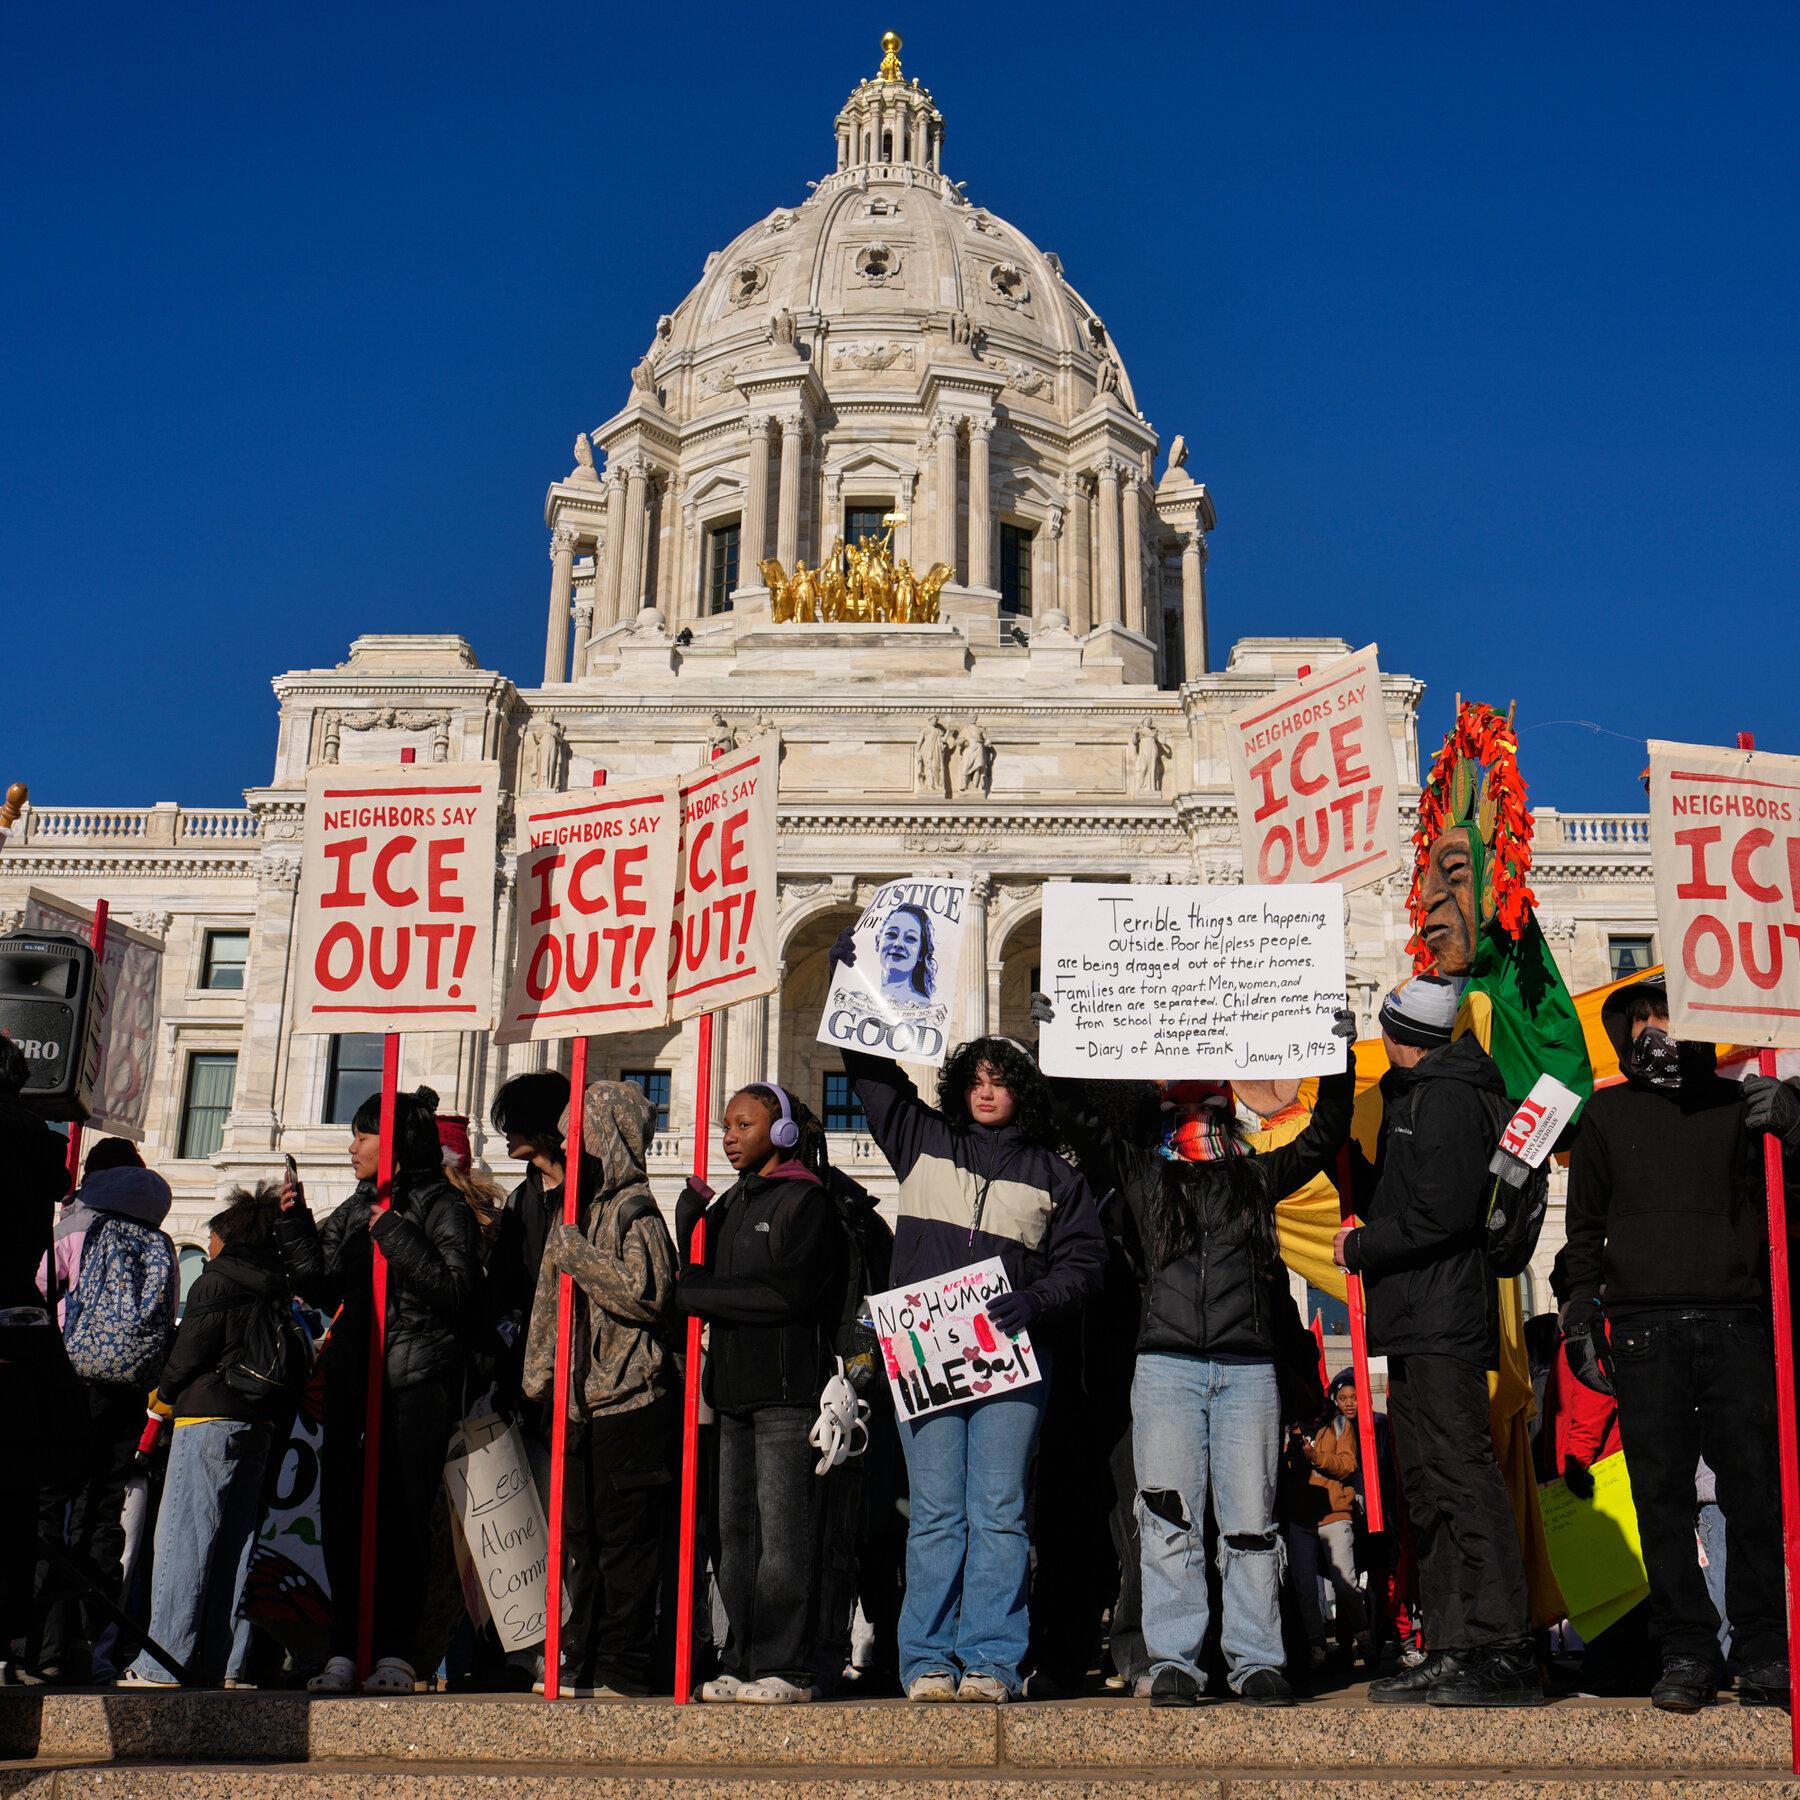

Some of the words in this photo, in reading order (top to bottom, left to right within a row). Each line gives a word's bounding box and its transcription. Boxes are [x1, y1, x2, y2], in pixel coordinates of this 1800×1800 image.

[1244, 699, 1333, 758] NEIGHBORS
[1337, 684, 1367, 711] SAY
[1249, 714, 1371, 824] ICE
[324, 806, 436, 831] NEIGHBORS
[441, 807, 477, 827] SAY
[679, 789, 729, 828] GHBORS
[732, 777, 758, 805] SAY
[1672, 794, 1793, 822] NEIGHBORS
[530, 818, 624, 852] NEIGHBORS
[628, 816, 661, 837] SAY
[1257, 784, 1384, 884] OUT!
[320, 835, 465, 913] ICE
[530, 845, 648, 926] ICE
[855, 909, 882, 933] for
[864, 884, 965, 924] JUSTICE
[1098, 897, 1181, 933] Terrible
[1188, 902, 1233, 938] things
[1238, 913, 1258, 923] are
[1263, 902, 1326, 930] happening
[314, 920, 477, 999] OUT!
[526, 924, 656, 1001] OUT!
[1108, 935, 1169, 952] outside.
[1171, 935, 1200, 952] Poor
[1204, 935, 1255, 955] helpless
[1259, 934, 1312, 953] people
[1057, 958, 1078, 969] are
[1082, 954, 1119, 977] being
[1126, 957, 1180, 980] dragged
[1188, 957, 1208, 969] out
[1213, 956, 1227, 968] of
[1230, 956, 1265, 969] their
[1268, 955, 1315, 969] homes.
[1054, 975, 1114, 1004] Families
[1118, 985, 1136, 995] are
[1140, 979, 1167, 995] torn
[1171, 979, 1207, 997] apart.
[1208, 974, 1237, 991] Men,
[1238, 979, 1280, 990] women,
[1280, 974, 1302, 987] and
[1070, 1000, 1122, 1014] children
[1127, 1001, 1145, 1011] are
[1154, 996, 1218, 1011] separated.
[1223, 992, 1276, 1008] Children
[1280, 993, 1309, 1003] come
[1313, 990, 1346, 1001] home
[828, 1010, 943, 1057] GOOD
[1075, 1015, 1104, 1030] from
[1113, 1013, 1152, 1027] school
[1159, 1013, 1175, 1026] to
[1178, 1012, 1207, 1026] find
[1212, 1011, 1238, 1025] that
[1240, 1009, 1270, 1022] their
[1271, 1005, 1311, 1022] parents
[1315, 1003, 1342, 1015] have
[1154, 1026, 1229, 1042] disappeared.
[1130, 1041, 1148, 1054] of
[1154, 1041, 1190, 1056] Anne
[1196, 1041, 1234, 1055] Frank
[1235, 1041, 1283, 1068] January
[1287, 1043, 1304, 1061] 13,
[1306, 1041, 1336, 1058] 1943
[1499, 1097, 1547, 1156] ICE
[932, 1328, 960, 1352] is
[481, 1516, 537, 1559] Alone
